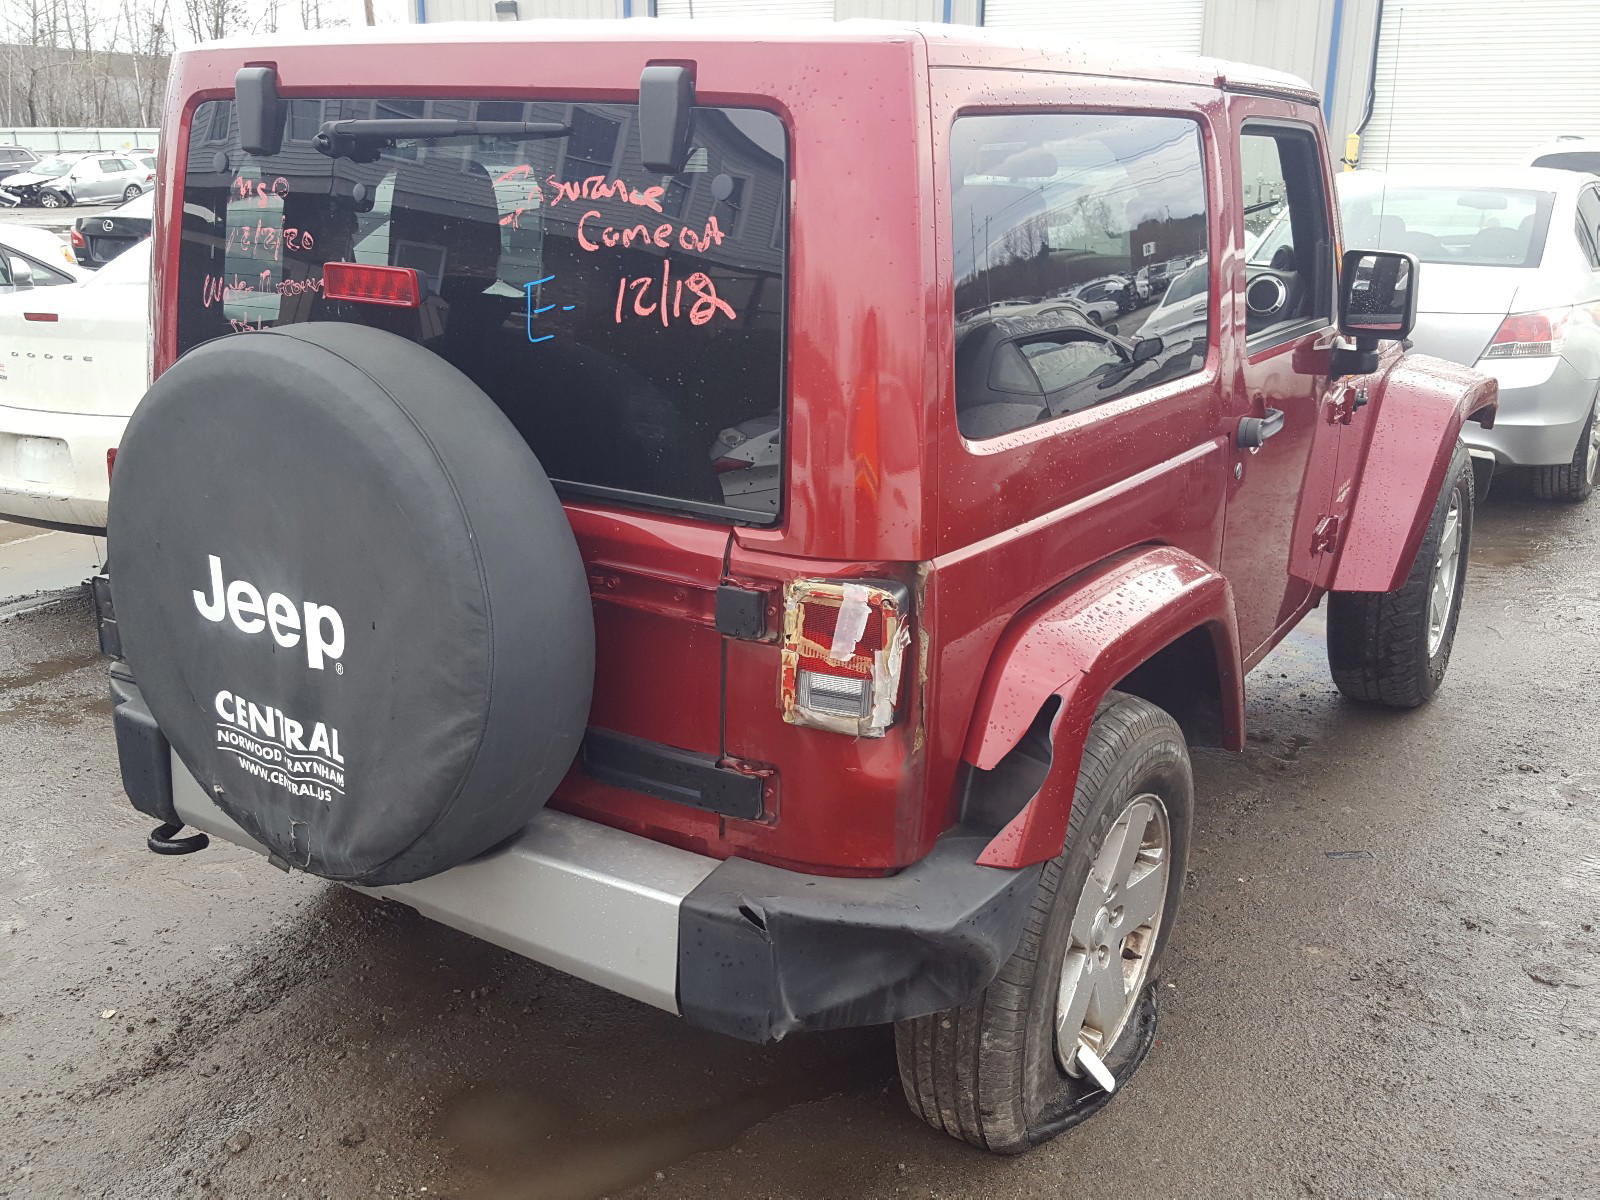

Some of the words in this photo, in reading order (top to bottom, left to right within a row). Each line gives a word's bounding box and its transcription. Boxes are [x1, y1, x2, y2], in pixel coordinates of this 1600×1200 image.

[192, 554, 346, 671] Jeep
[215, 690, 345, 764] CENTRAL
[217, 729, 282, 761] NORWOOD
[238, 756, 332, 802] WWW.CENTRAL.US
